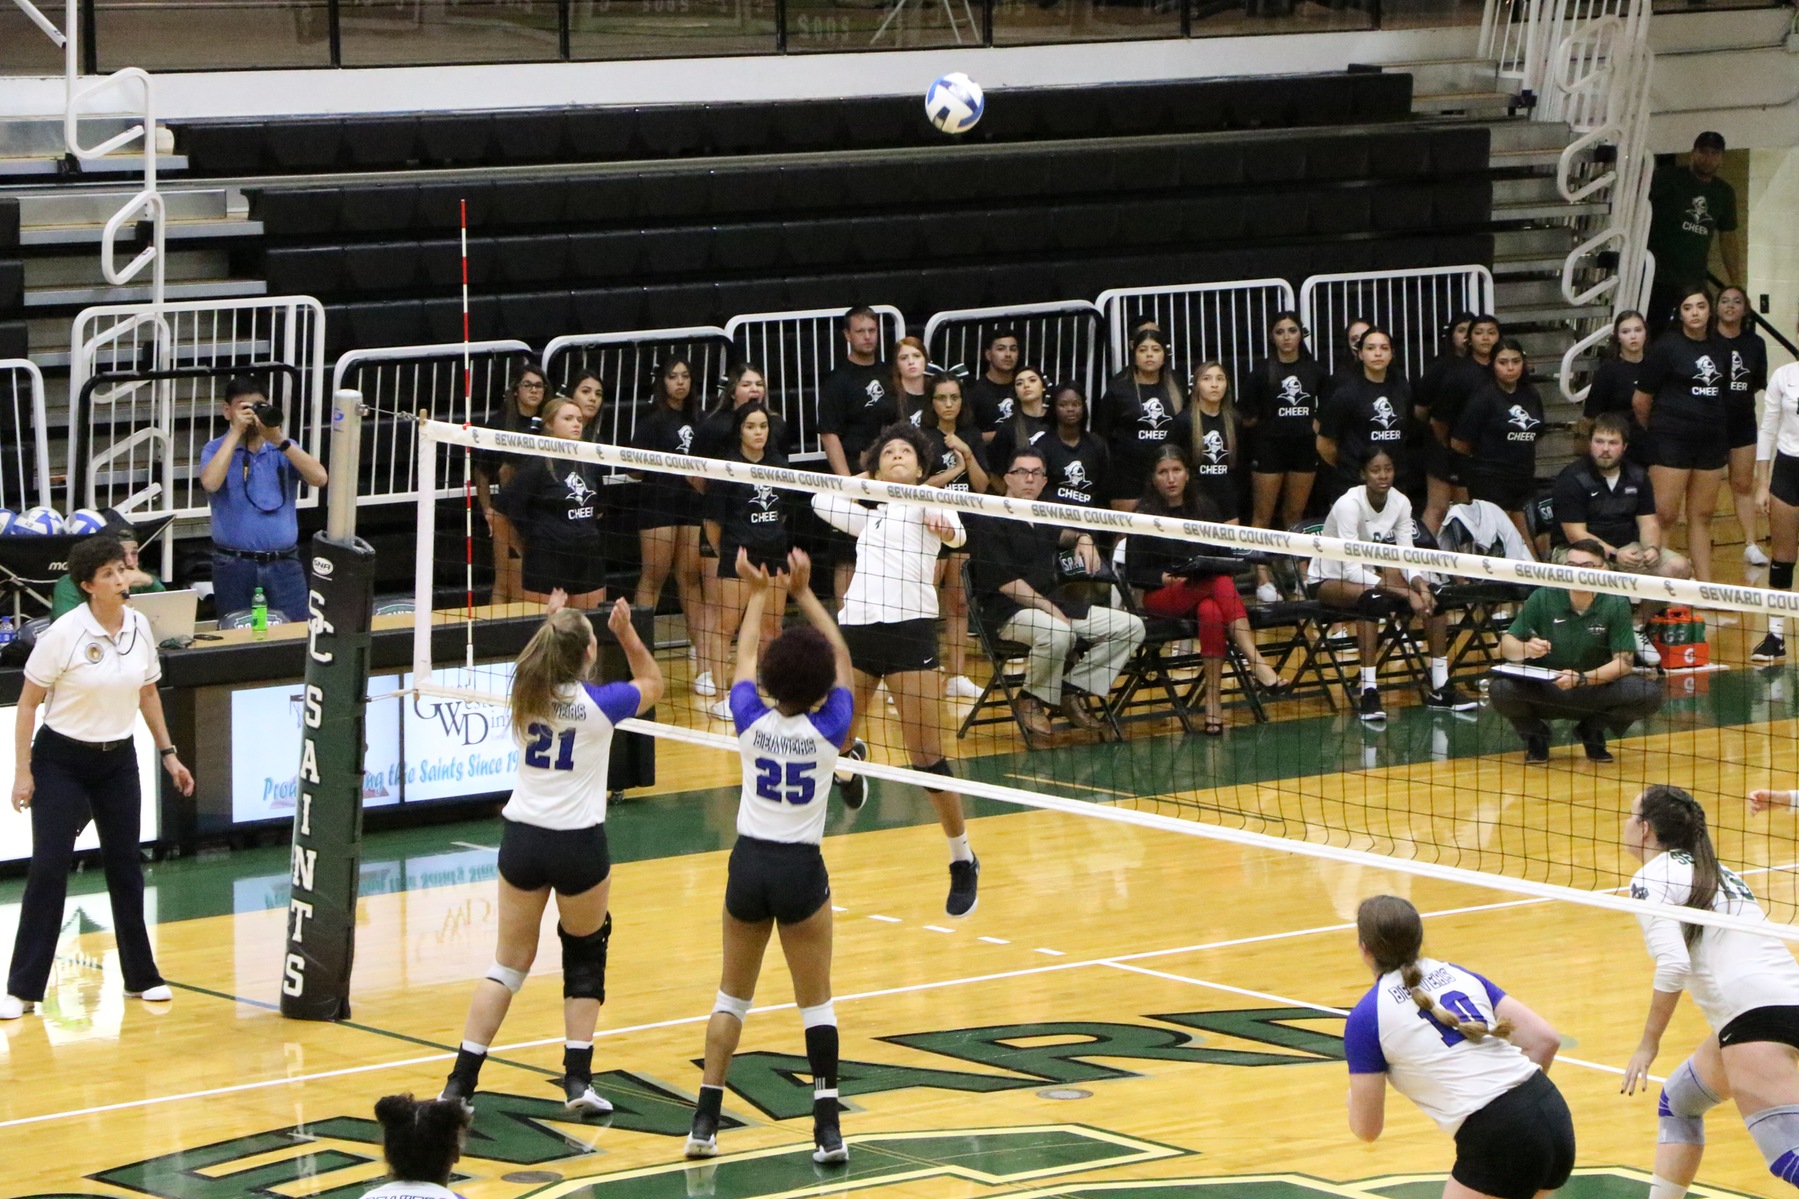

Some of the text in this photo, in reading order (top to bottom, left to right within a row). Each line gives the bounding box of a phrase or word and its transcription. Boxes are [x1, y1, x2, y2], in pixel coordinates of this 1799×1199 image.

[1682, 221, 1708, 235] CHEER
[1692, 387, 1719, 396] CHEE
[1730, 382, 1748, 391] EER
[1278, 406, 1310, 417] CHEER
[1371, 430, 1401, 440] CHEER
[1507, 432, 1536, 442] CHEER
[1200, 465, 1228, 475] CHEER
[945, 484, 969, 493] HEER
[1058, 488, 1092, 503] CHEER
[494, 433, 535, 450] SEWARD
[538, 439, 579, 455] COUNTY
[620, 450, 663, 466] SEWARD
[665, 456, 707, 472] COUNTY
[750, 467, 796, 483] SEWARD
[798, 474, 843, 491] COUNTY
[887, 485, 934, 503] SEWARD
[937, 491, 984, 509] COUNTY
[1031, 504, 1081, 522] SEWARD
[1084, 511, 1133, 528] COUNTY
[1183, 523, 1236, 542] SEWARD
[1239, 529, 1291, 548] COUNTY
[1344, 542, 1400, 561] SEWARD
[1403, 549, 1459, 568] COUNTY
[1515, 564, 1574, 583] SEWARD
[1578, 571, 1639, 591] COUNTY
[1699, 586, 1763, 606] SEWARD
[525, 722, 576, 771] 21
[263, 777, 298, 801] Prou
[420, 757, 463, 782] Saints
[468, 750, 503, 776] Since
[755, 757, 817, 806] 25
[283, 687, 324, 998] SAINTS
[1388, 968, 1457, 1004] BEVERS
[1417, 990, 1488, 1048] 10
